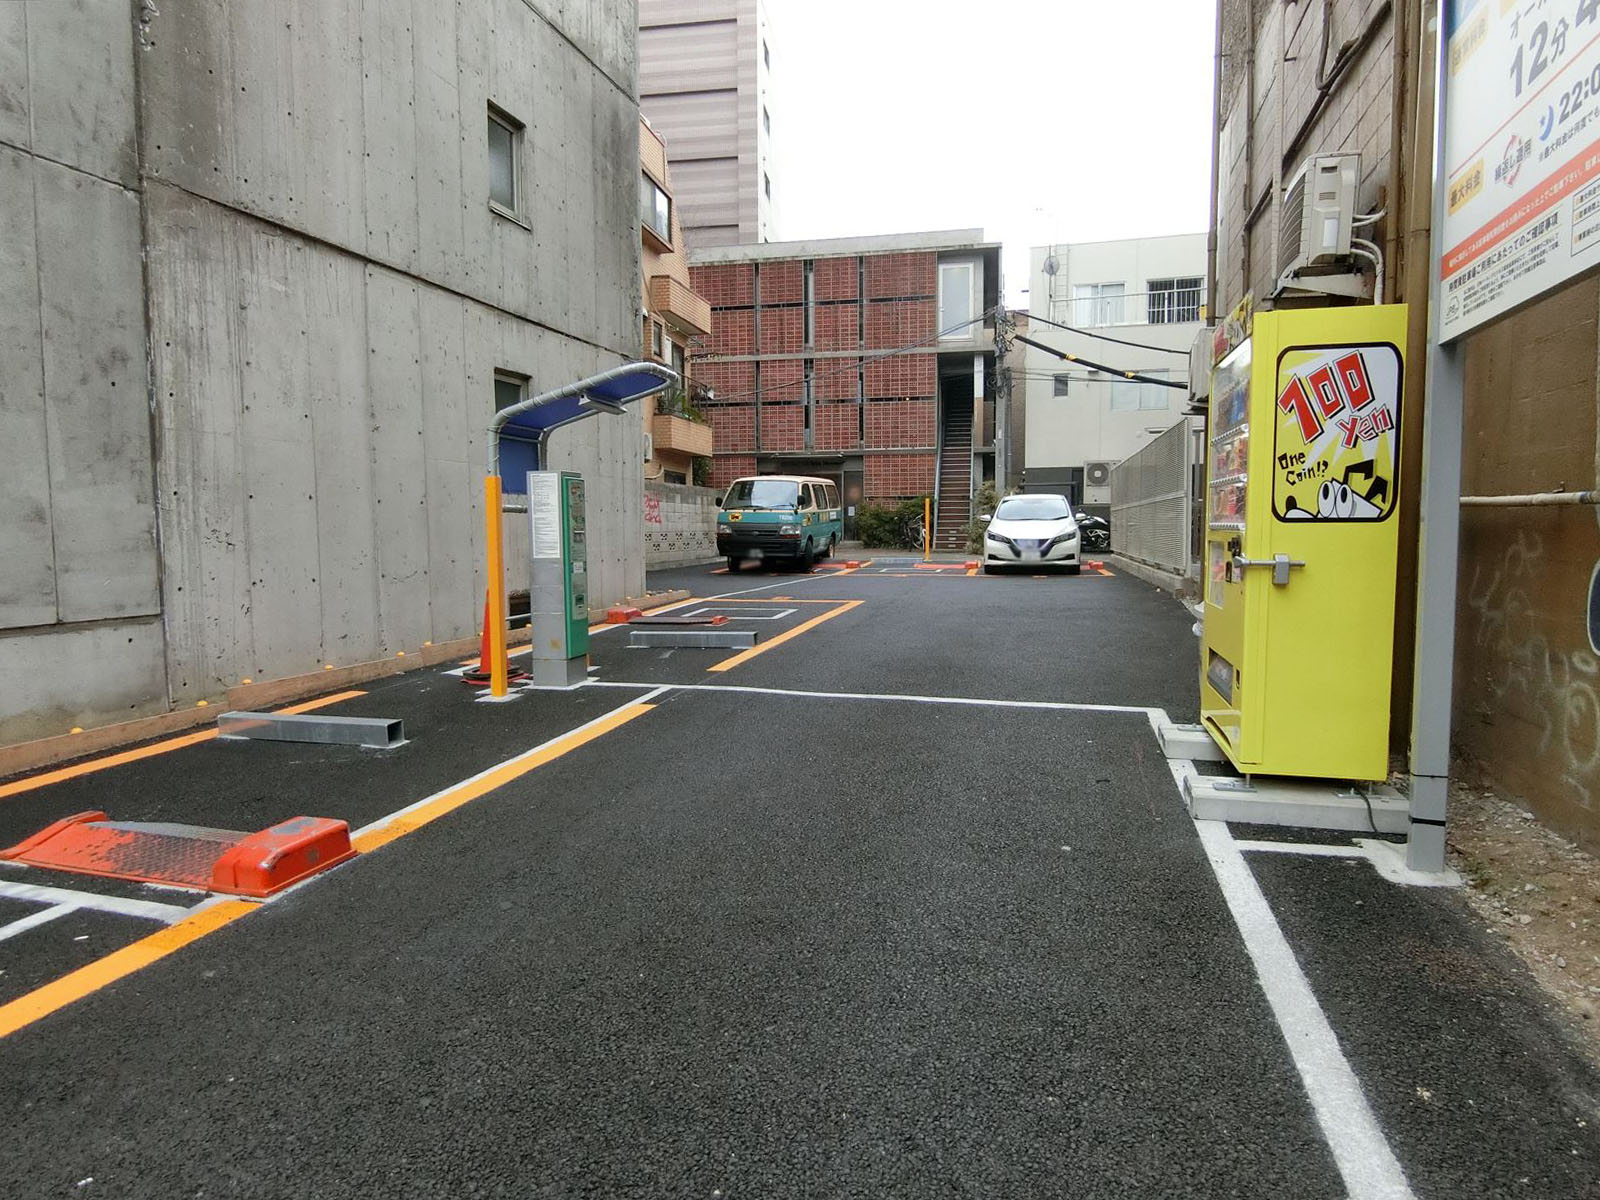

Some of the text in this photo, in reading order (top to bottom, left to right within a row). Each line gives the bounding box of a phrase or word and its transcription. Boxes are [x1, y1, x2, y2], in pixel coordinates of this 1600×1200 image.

[1449, 169, 1482, 208] 最大料金
[1277, 350, 1375, 445] 100
[1278, 452, 1306, 470] One
[1286, 460, 1329, 486] Coin!?
